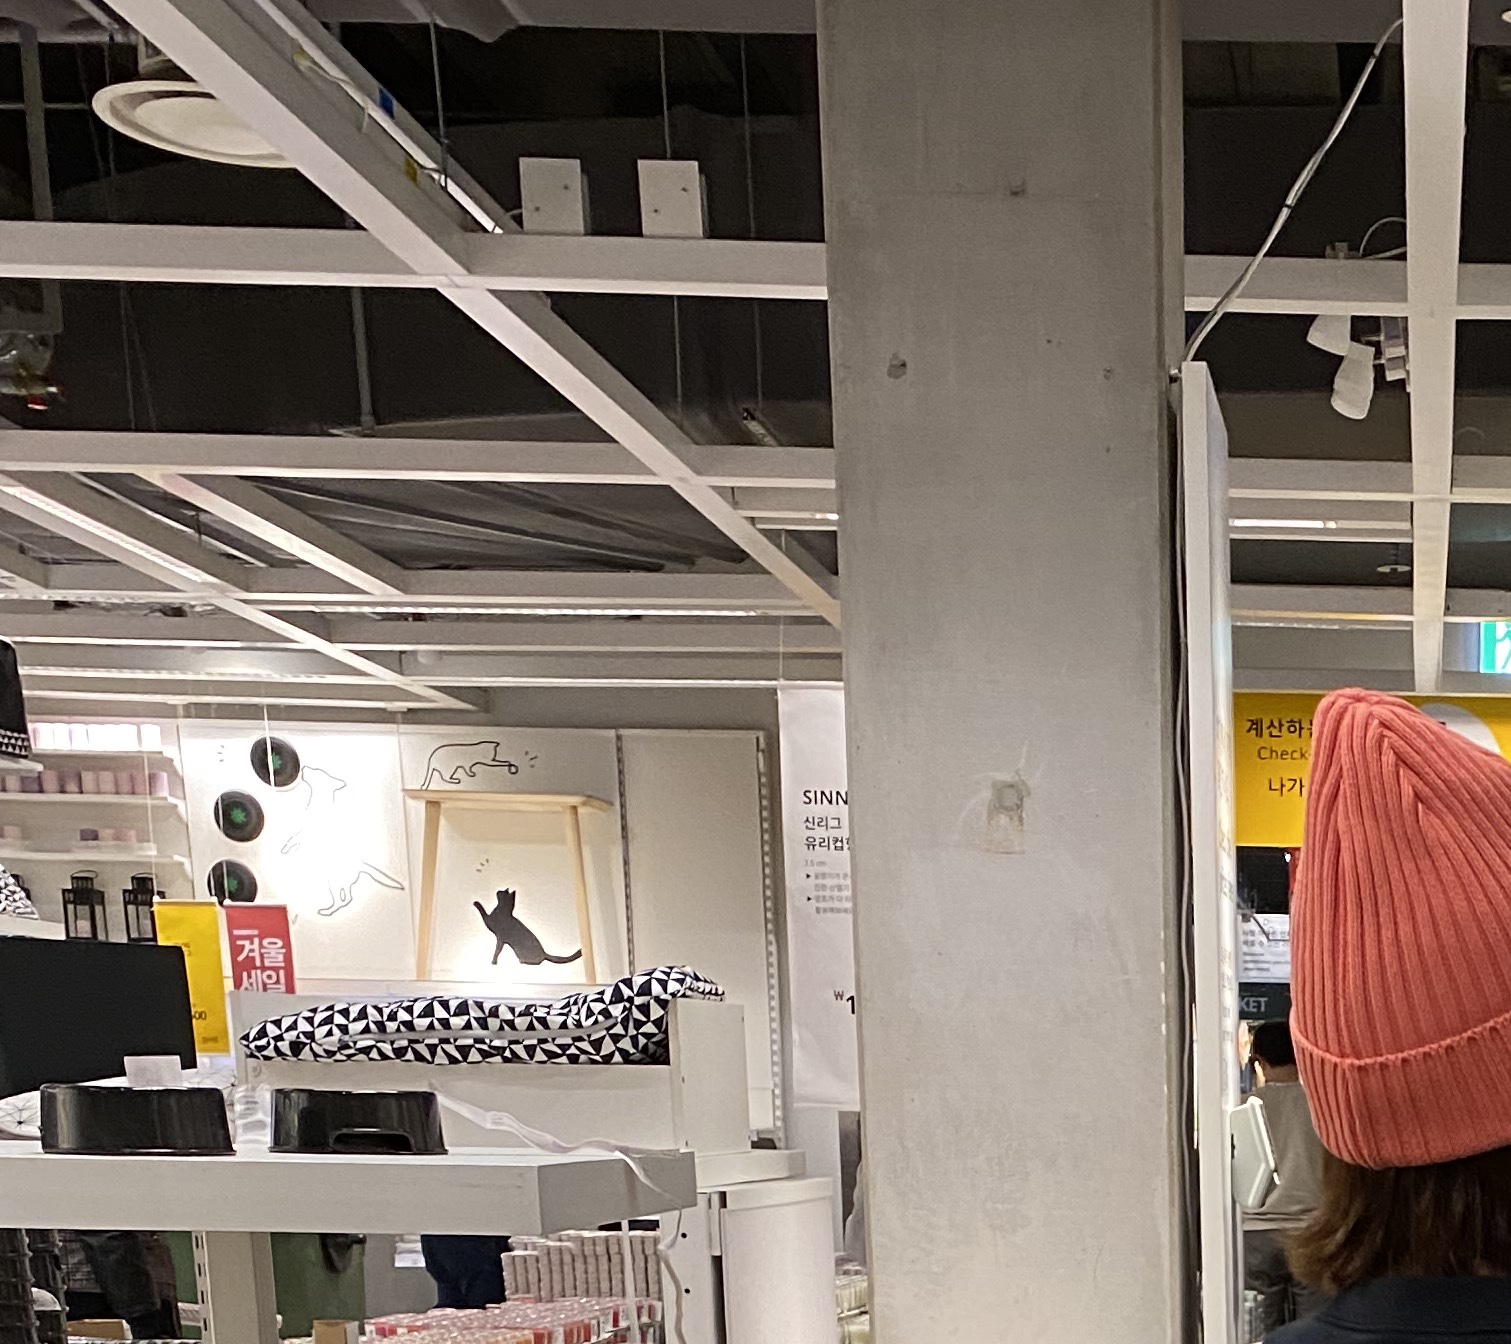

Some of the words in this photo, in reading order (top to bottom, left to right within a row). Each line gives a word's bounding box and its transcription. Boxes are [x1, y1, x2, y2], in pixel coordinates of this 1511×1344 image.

[1268, 777, 1305, 797] 나가
[803, 789, 848, 806] SINN
[804, 816, 842, 831] 신리그
[236, 937, 286, 967] 겨울
[239, 969, 286, 993] 세일
